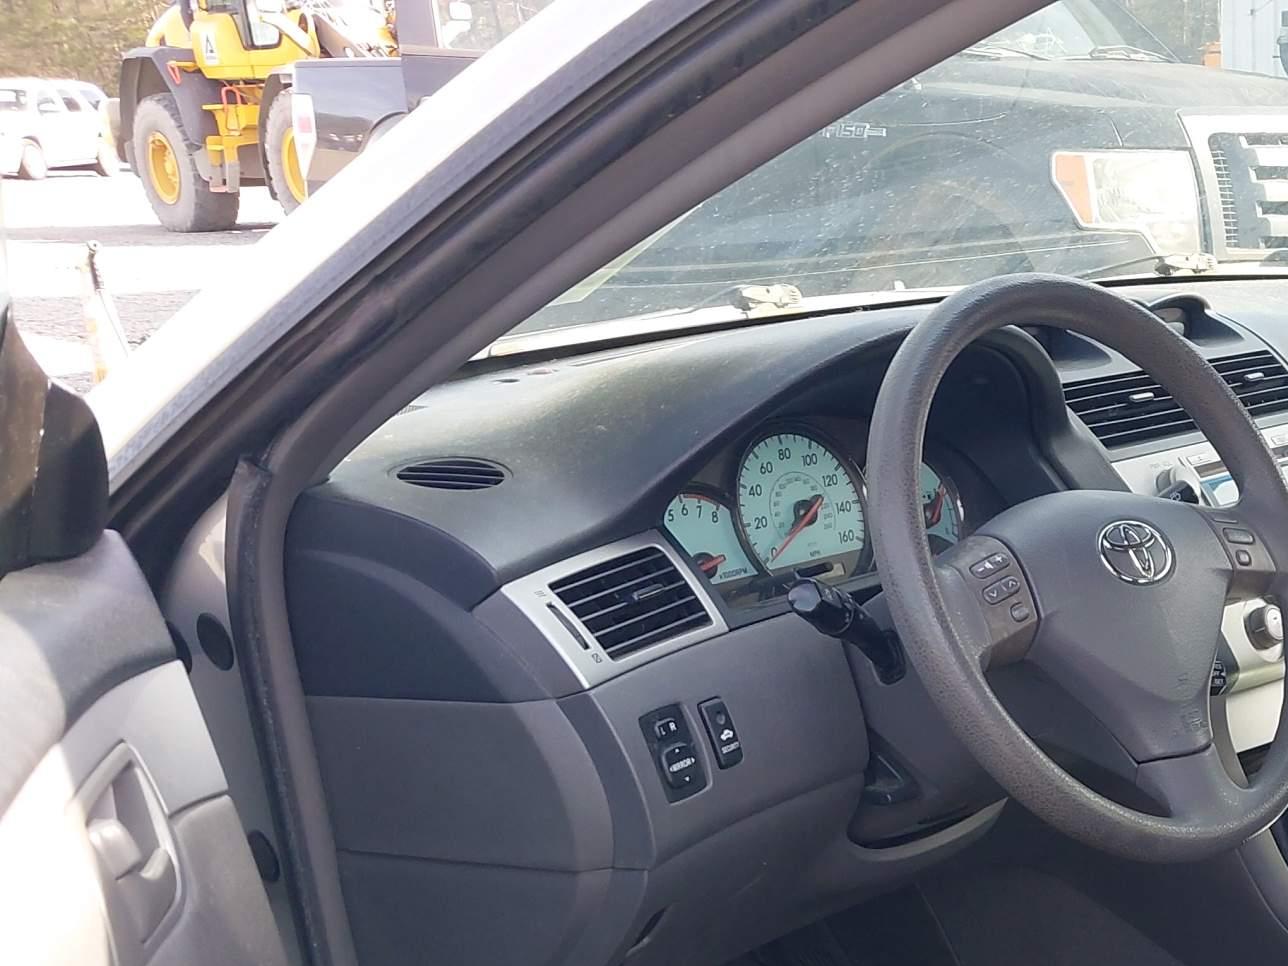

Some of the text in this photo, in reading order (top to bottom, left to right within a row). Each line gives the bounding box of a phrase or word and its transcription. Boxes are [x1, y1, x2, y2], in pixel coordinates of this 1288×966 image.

[778, 447, 791, 460] 80
[801, 453, 818, 467] 100
[759, 461, 773, 474] 60
[822, 473, 838, 486] 120
[748, 484, 763, 497] 40
[667, 508, 675, 522] 5
[681, 504, 689, 516] 6
[696, 505, 702, 519] 7
[836, 502, 852, 515] 140
[711, 511, 719, 523] 8
[755, 516, 768, 530] 20
[838, 530, 855, 544] 160
[660, 722, 677, 736] L R
